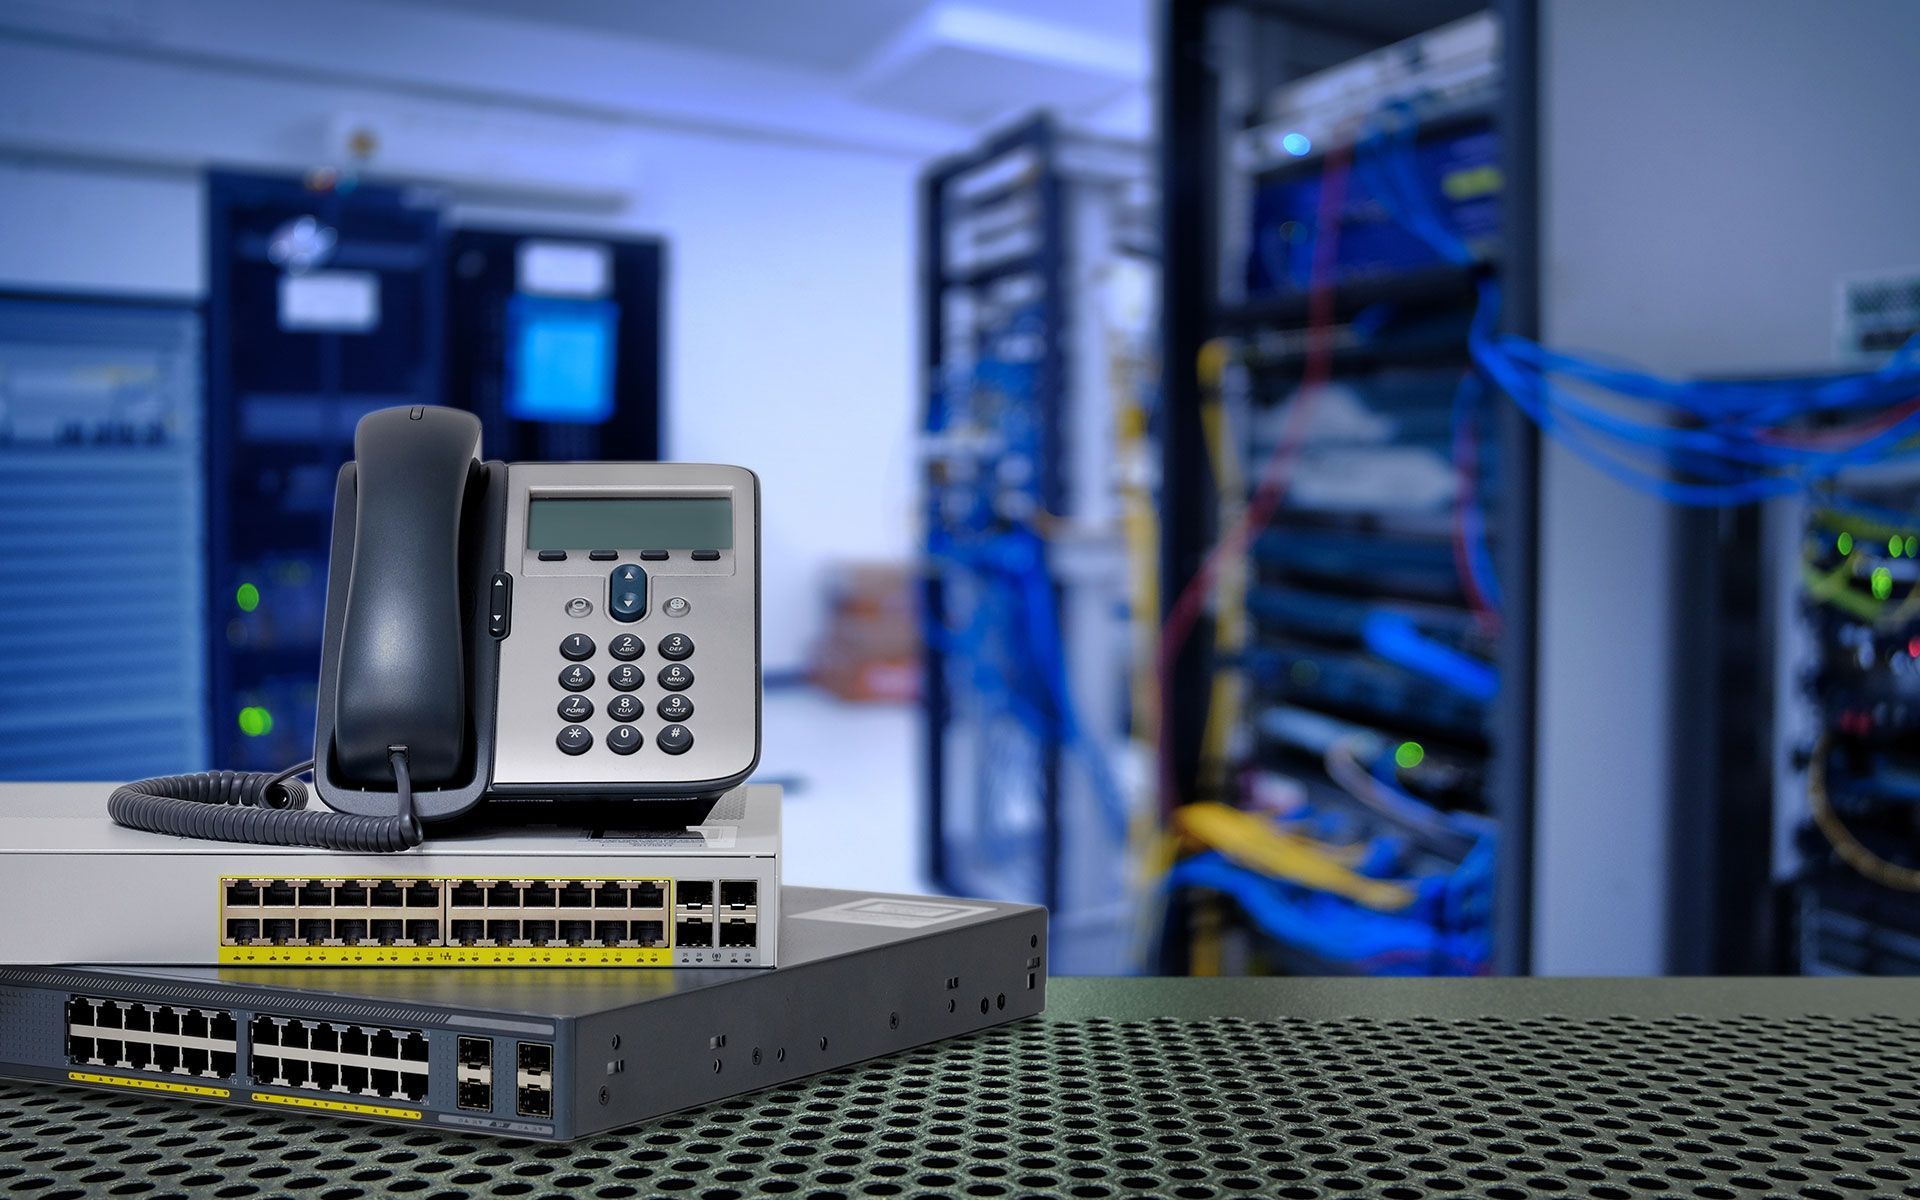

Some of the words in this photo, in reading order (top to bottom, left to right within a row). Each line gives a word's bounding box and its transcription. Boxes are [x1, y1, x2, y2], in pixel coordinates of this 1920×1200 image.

[574, 637, 580, 646] 1
[623, 637, 632, 647] 2
[673, 637, 681, 646] 3
[573, 668, 581, 677] 4
[623, 668, 631, 677] 5
[672, 667, 680, 677] 6
[572, 698, 580, 707] 7
[621, 698, 630, 707] 8
[672, 698, 680, 707] 9
[620, 729, 629, 738] 0
